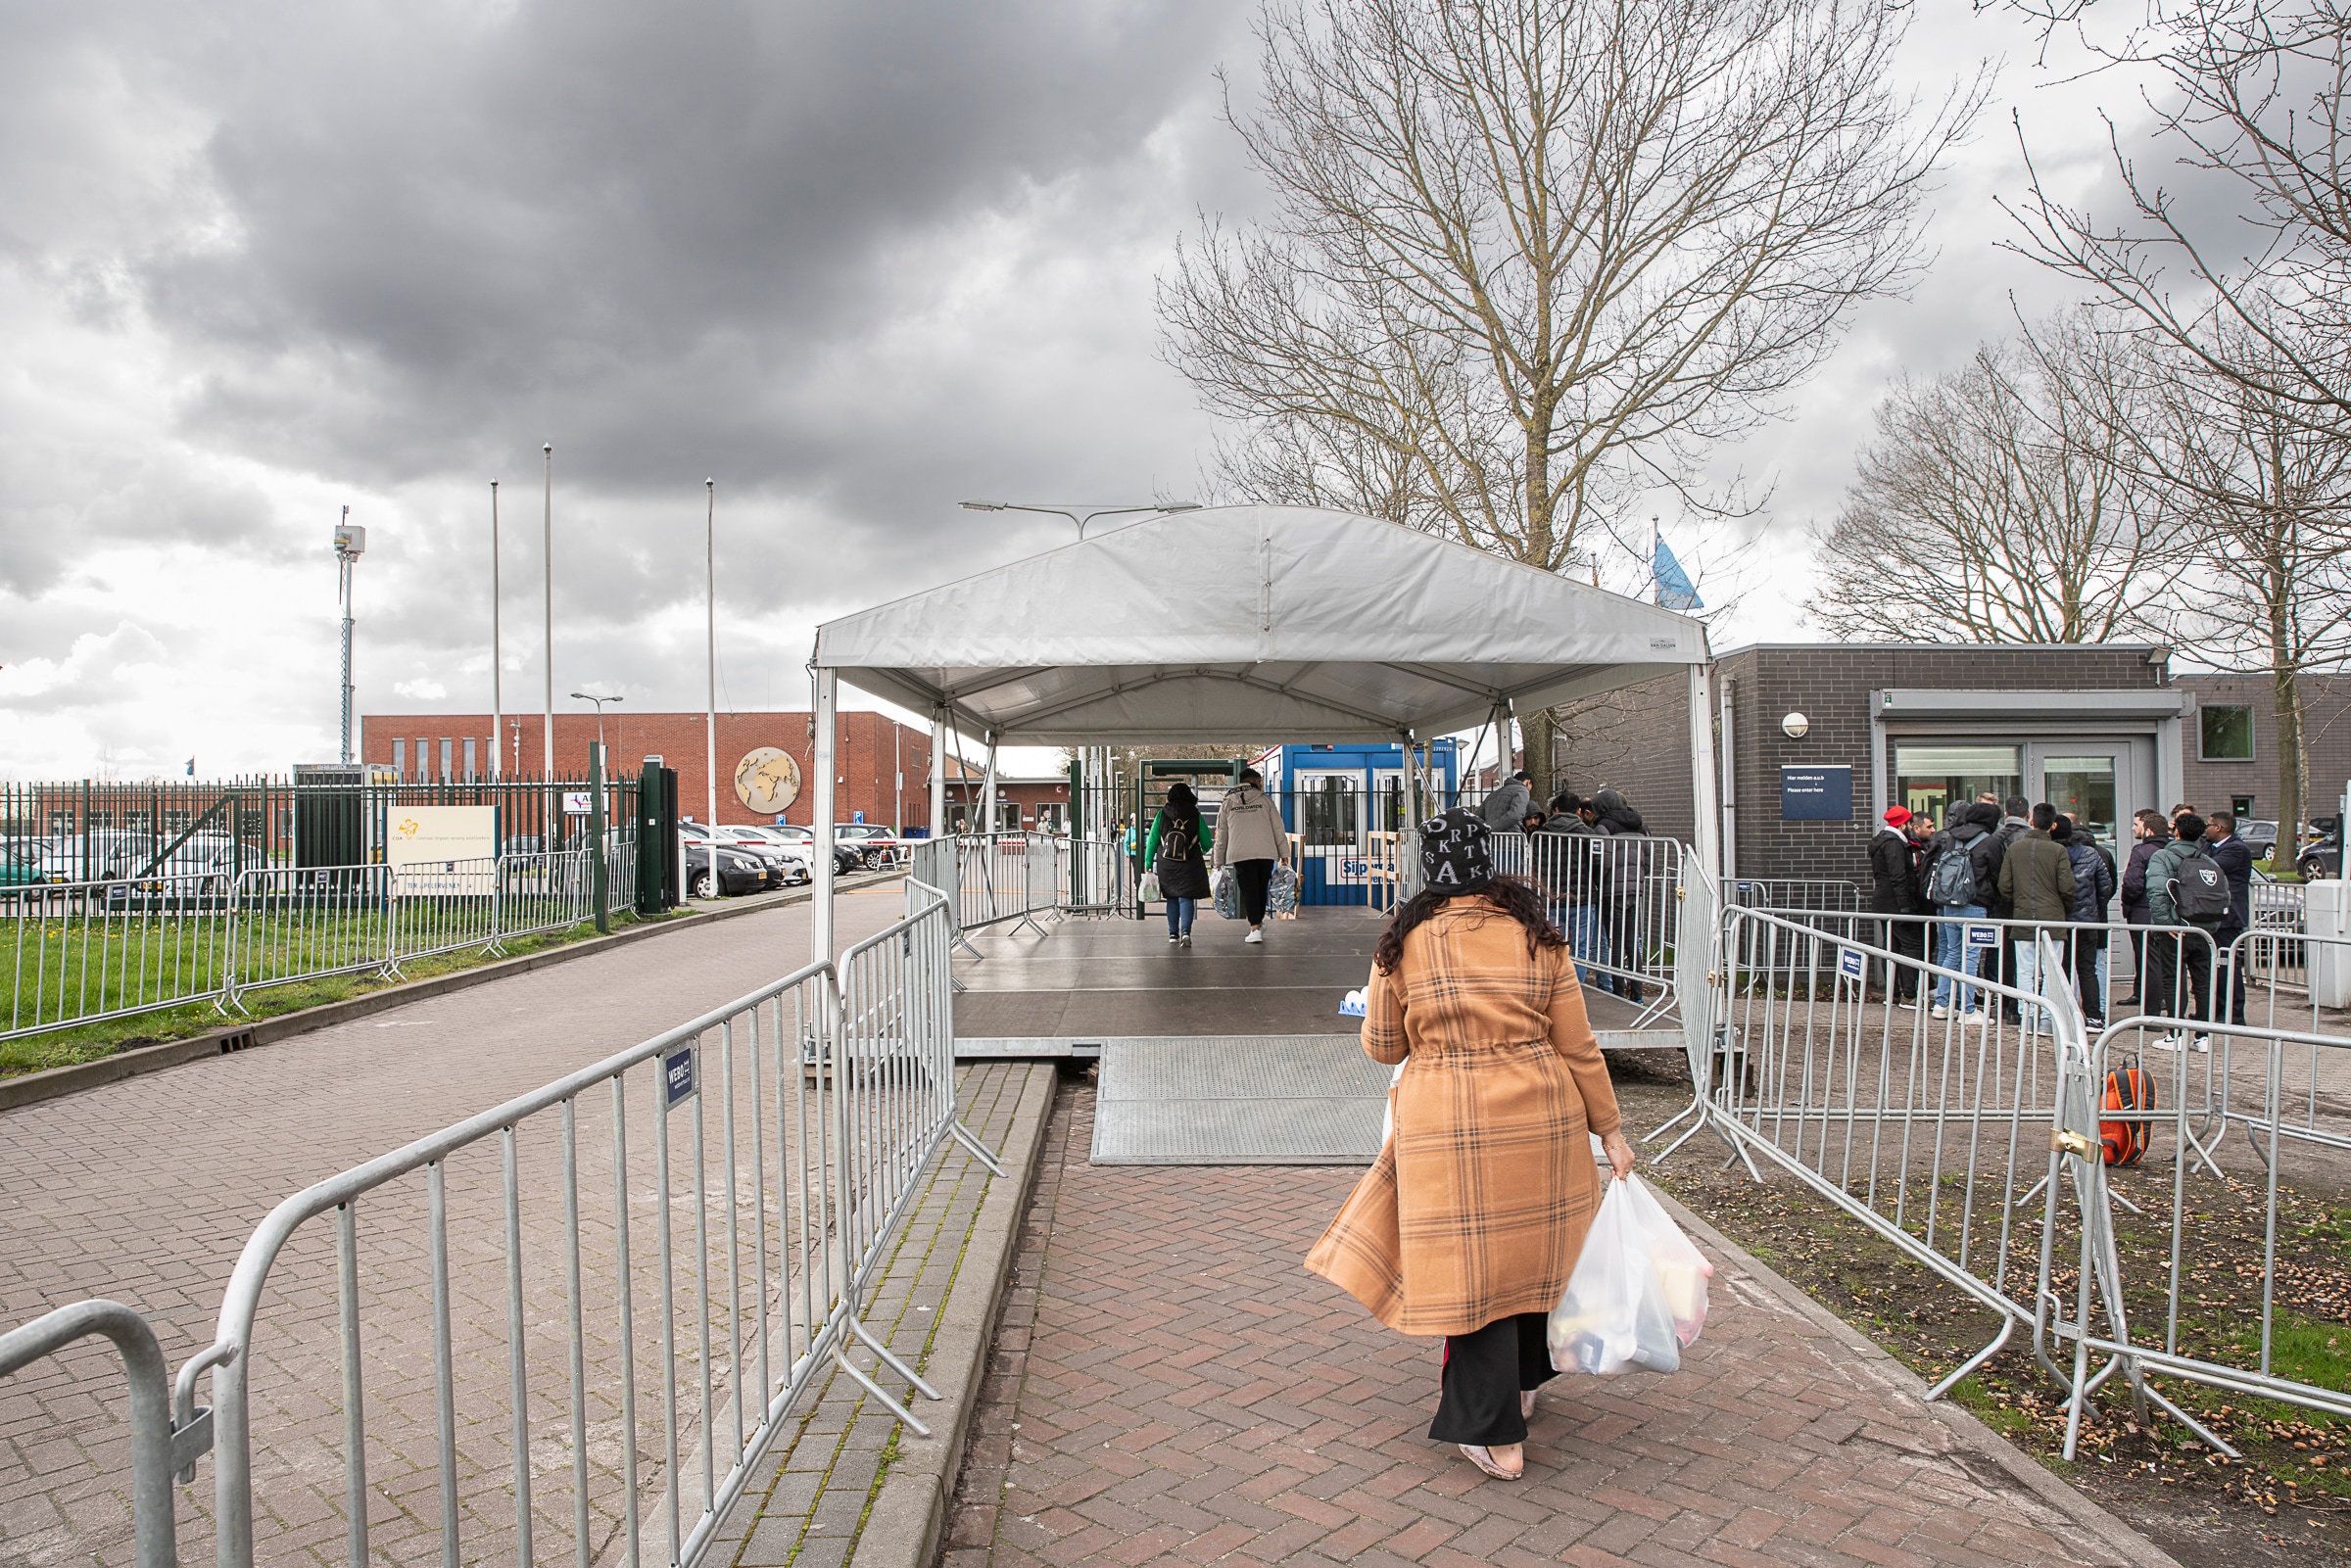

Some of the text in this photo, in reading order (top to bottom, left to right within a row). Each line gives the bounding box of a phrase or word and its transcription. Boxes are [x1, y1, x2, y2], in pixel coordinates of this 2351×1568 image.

[1450, 829, 1463, 843] R
[1466, 824, 1478, 838] P
[1438, 839, 1452, 853] K
[1463, 844, 1475, 859] T
[1425, 851, 1435, 865] S
[1434, 860, 1462, 884] A
[1469, 865, 1483, 879] K
[668, 1064, 685, 1085] WEBO
